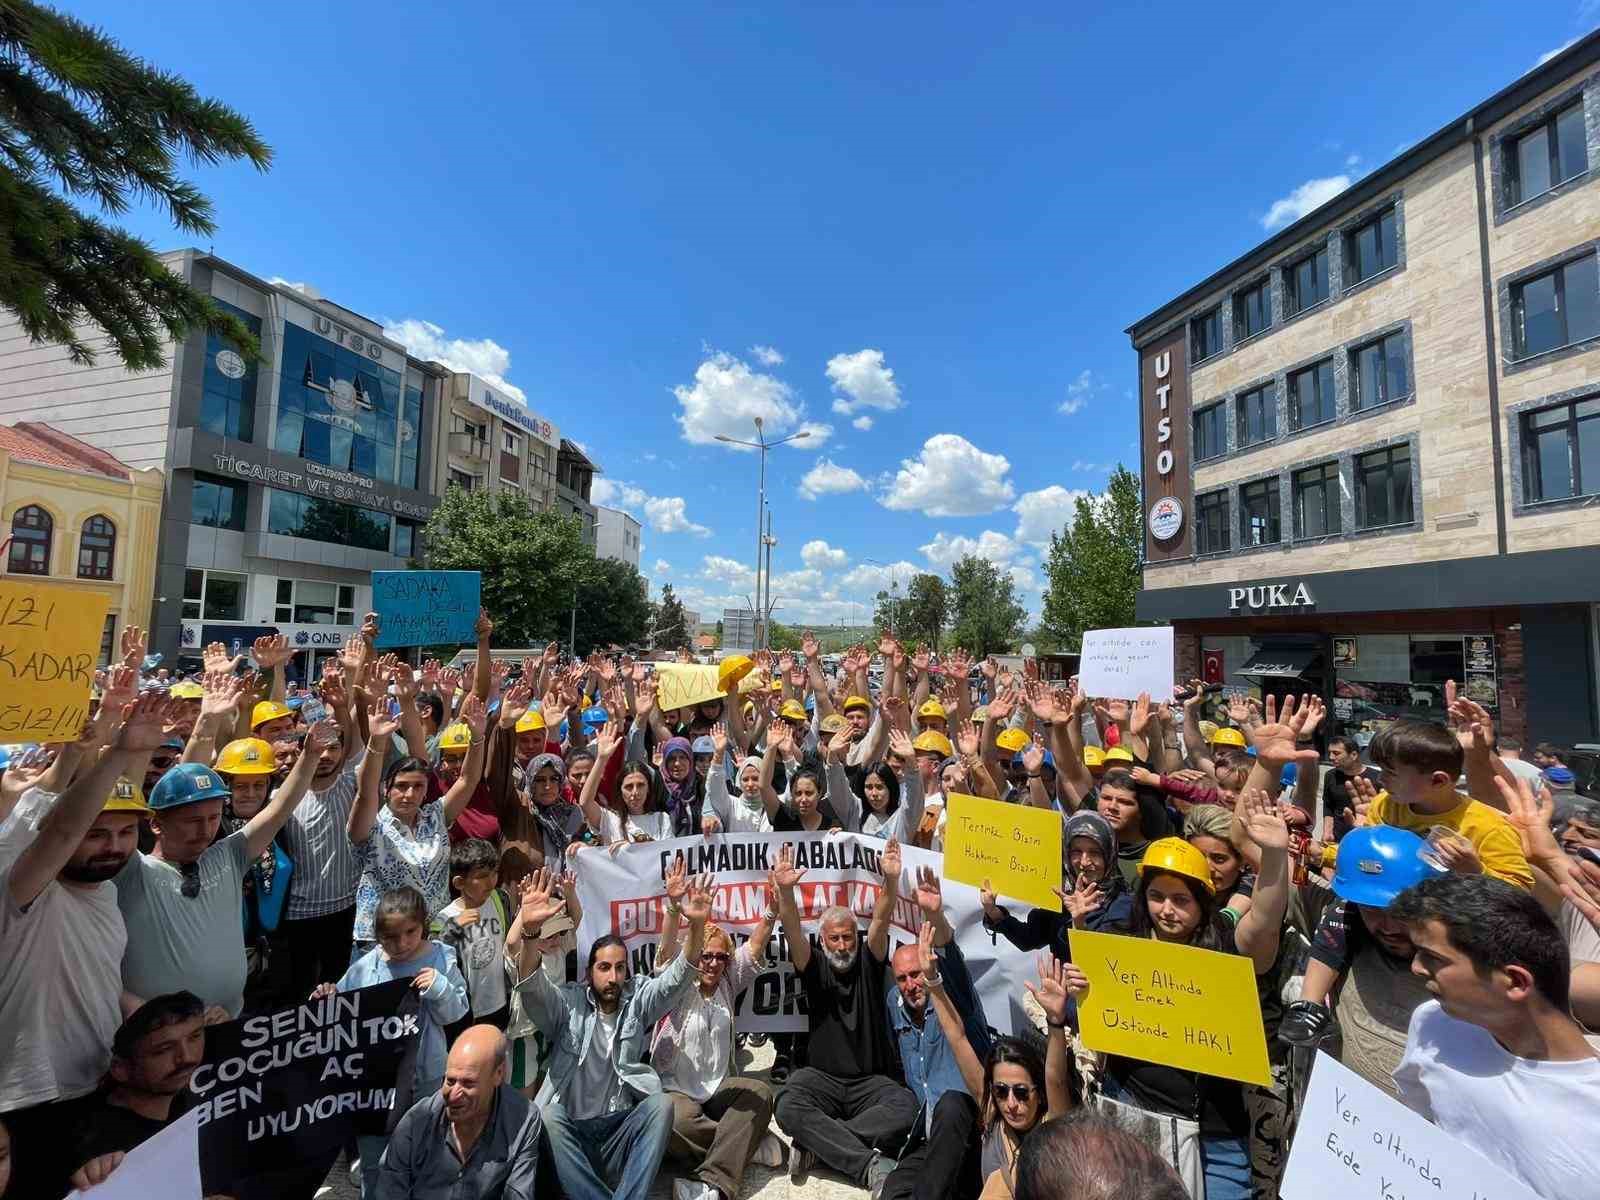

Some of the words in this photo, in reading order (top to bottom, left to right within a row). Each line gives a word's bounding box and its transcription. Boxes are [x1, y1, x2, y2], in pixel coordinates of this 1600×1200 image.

[313, 313, 383, 360] UTSO
[1154, 351, 1174, 476] UTSO
[1228, 582, 1315, 609] PUKA
[311, 632, 342, 645] QNB
[617, 900, 657, 937] BU
[1105, 957, 1140, 983] Yer
[1135, 988, 1176, 1008] Emek
[362, 1014, 419, 1045] TOK
[320, 1052, 364, 1082] AÇ
[195, 1081, 263, 1128] BEN
[1335, 1086, 1361, 1126] Yer
[1326, 1131, 1362, 1176] Evde
